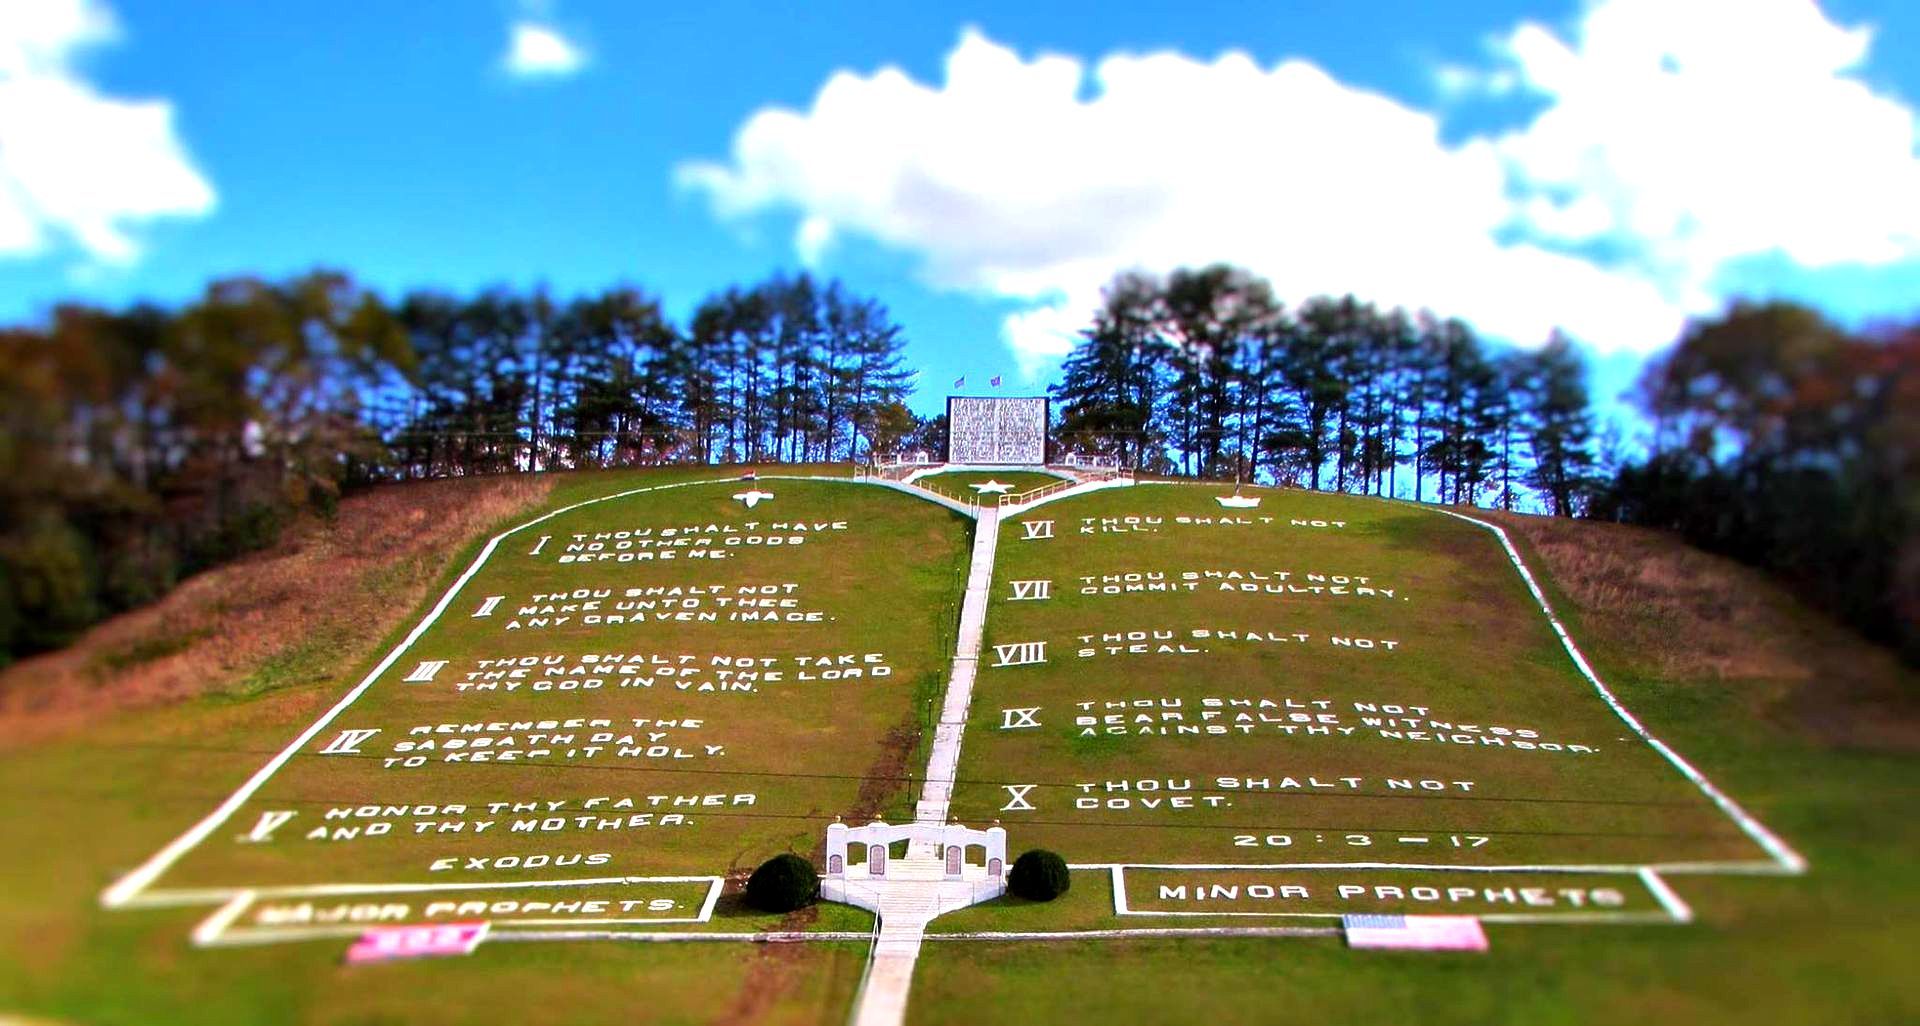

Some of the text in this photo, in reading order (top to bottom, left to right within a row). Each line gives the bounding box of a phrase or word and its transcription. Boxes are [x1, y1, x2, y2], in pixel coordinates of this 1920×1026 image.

[573, 521, 847, 542] THOU SHALT HAVE
[1020, 520, 1055, 540] VI
[1080, 516, 1345, 528] THOU SHALT NOT
[1080, 524, 1157, 534] KILL.
[529, 535, 552, 555] I
[566, 536, 804, 552] NO OTHER GODS
[558, 549, 734, 563] BEFORE ME.
[1079, 570, 1369, 584] THOU SHALT NOT
[532, 583, 798, 603] THOU SHALT NOT
[1007, 580, 1052, 601] VII
[1081, 582, 1199, 594] COMMIT
[471, 595, 505, 618] II
[518, 597, 798, 616] MAKE UNTO THEE
[505, 616, 570, 630] ANY
[583, 611, 717, 624] GRAVEN
[1078, 629, 1398, 650] THOU SHALT NOT
[991, 641, 1048, 667] VIII
[1078, 643, 1209, 658] STEAL.
[478, 653, 883, 669] THOU SHALT NOT TAKE
[402, 660, 450, 682] III
[466, 664, 891, 681] THE NAME OF THE LORD
[456, 677, 758, 693] THY GOD IN VAIN.
[1076, 698, 1429, 716] THOU SHALT NOT
[409, 718, 704, 735] REMEMBER THE
[999, 706, 1042, 729] IX
[1076, 711, 1539, 739] BEAR FALSE WITNESS
[1278, 725, 1355, 735] THY
[319, 728, 382, 754] IV
[393, 732, 667, 752] SABBATH DAY
[384, 745, 725, 768] TO KEEP IT HOLY.
[1076, 777, 1474, 793] THOU SHALT NOT
[325, 793, 756, 820] HONOR THY FATHER
[999, 784, 1038, 811] X
[1076, 796, 1232, 809] COVET.
[235, 811, 298, 842] V
[308, 813, 694, 840] AND THY MOTHER.
[429, 853, 612, 871] EXODUS
[1159, 884, 1309, 901] MINOR
[425, 899, 684, 917] PROPHETS.
